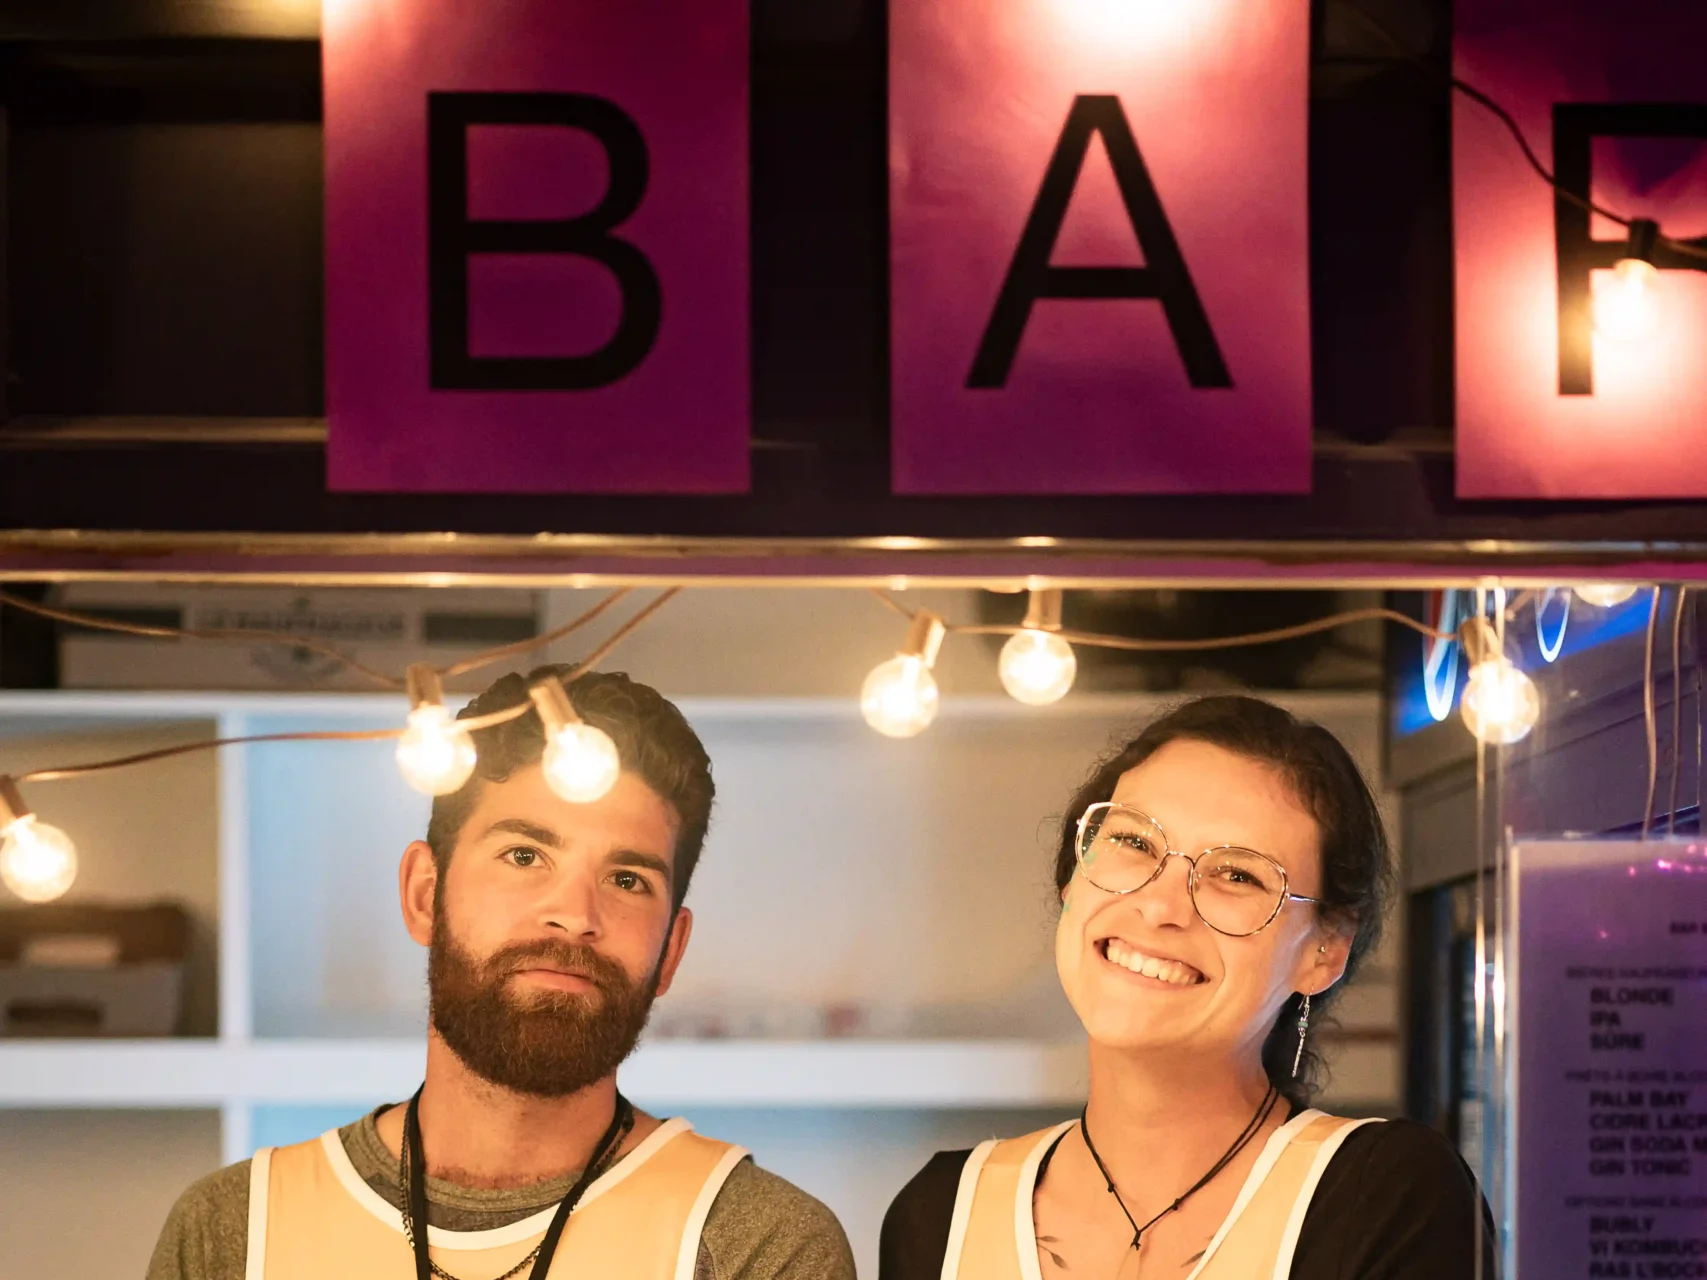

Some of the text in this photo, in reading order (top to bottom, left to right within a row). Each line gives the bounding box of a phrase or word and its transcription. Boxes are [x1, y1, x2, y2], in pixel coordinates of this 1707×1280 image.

[1589, 987, 1673, 1004] BLONDE
[1589, 1009, 1621, 1025] IPA
[1589, 1089, 1688, 1108] PALM BAY
[1588, 1137, 1625, 1153] GIN
[1630, 1136, 1686, 1153] SODA
[1588, 1159, 1692, 1176] GIN TONIC
[1589, 1215, 1654, 1232] BUBLY
[1588, 1261, 1630, 1278] RAS
